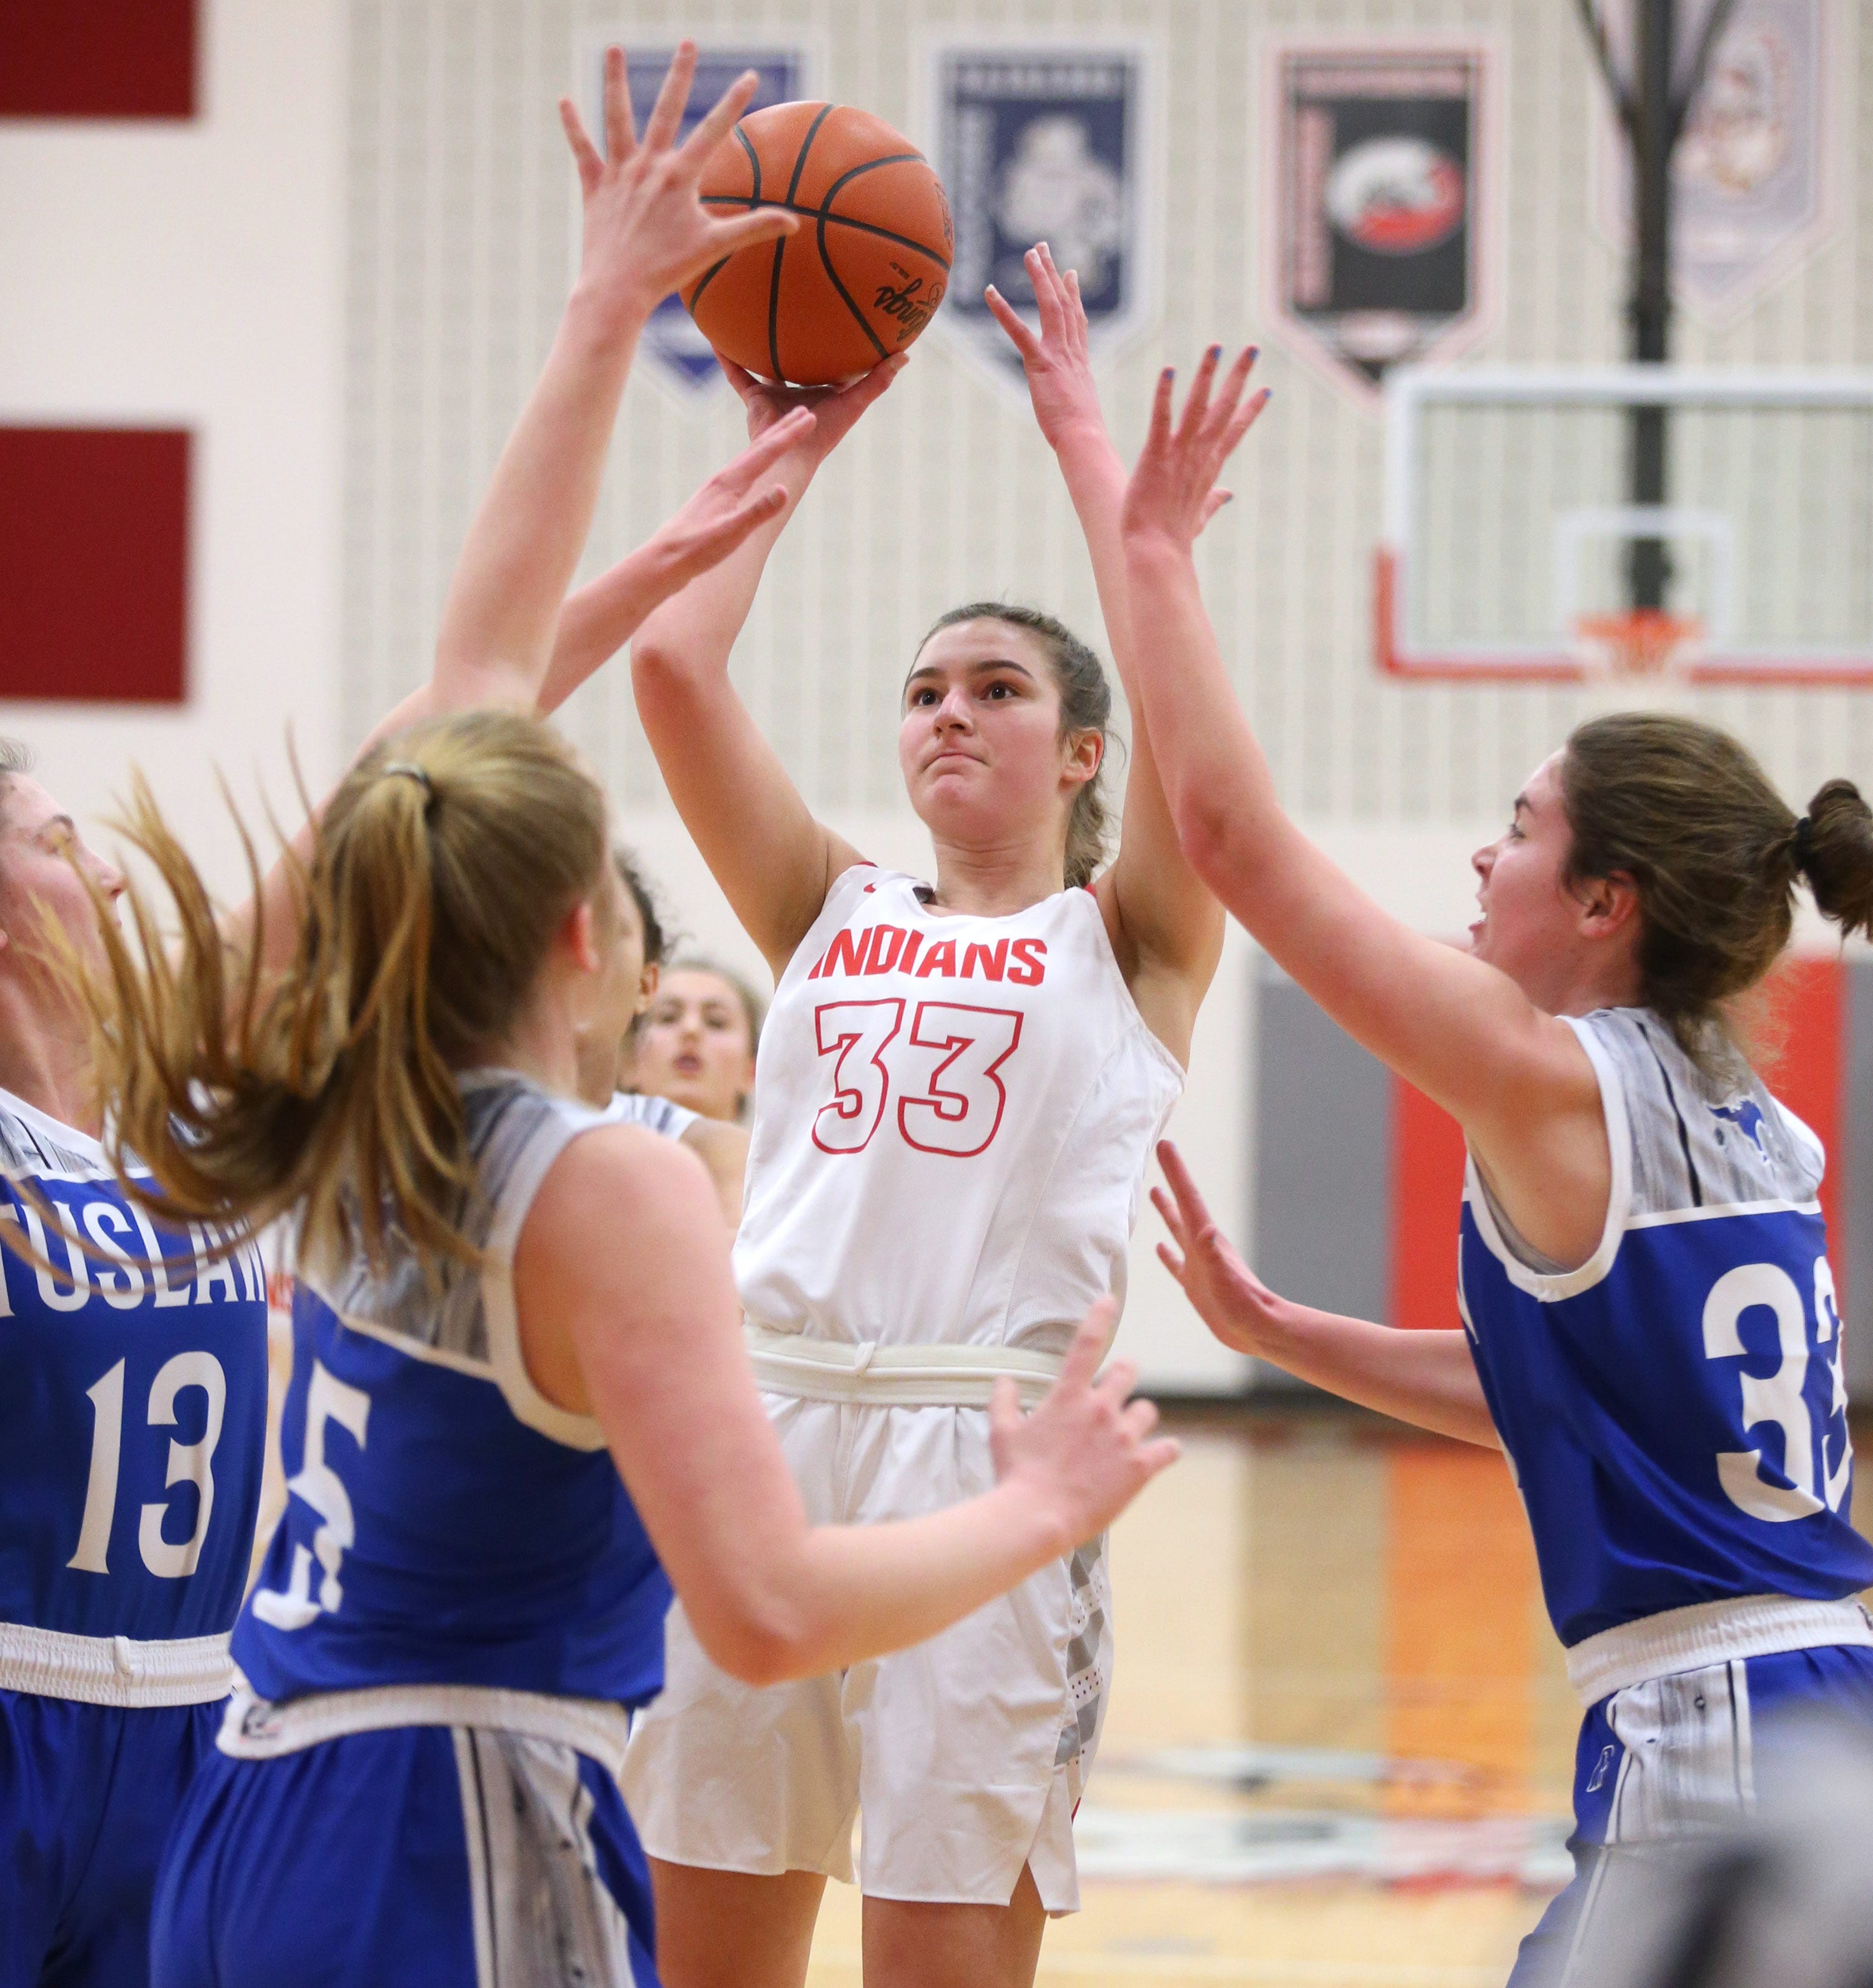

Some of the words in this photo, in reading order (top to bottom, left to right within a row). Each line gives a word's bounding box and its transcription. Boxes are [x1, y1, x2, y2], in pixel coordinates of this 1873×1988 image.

[812, 998, 1024, 1157] 33
[67, 1351, 227, 1578] 13
[1703, 1256, 1852, 1522] 33
